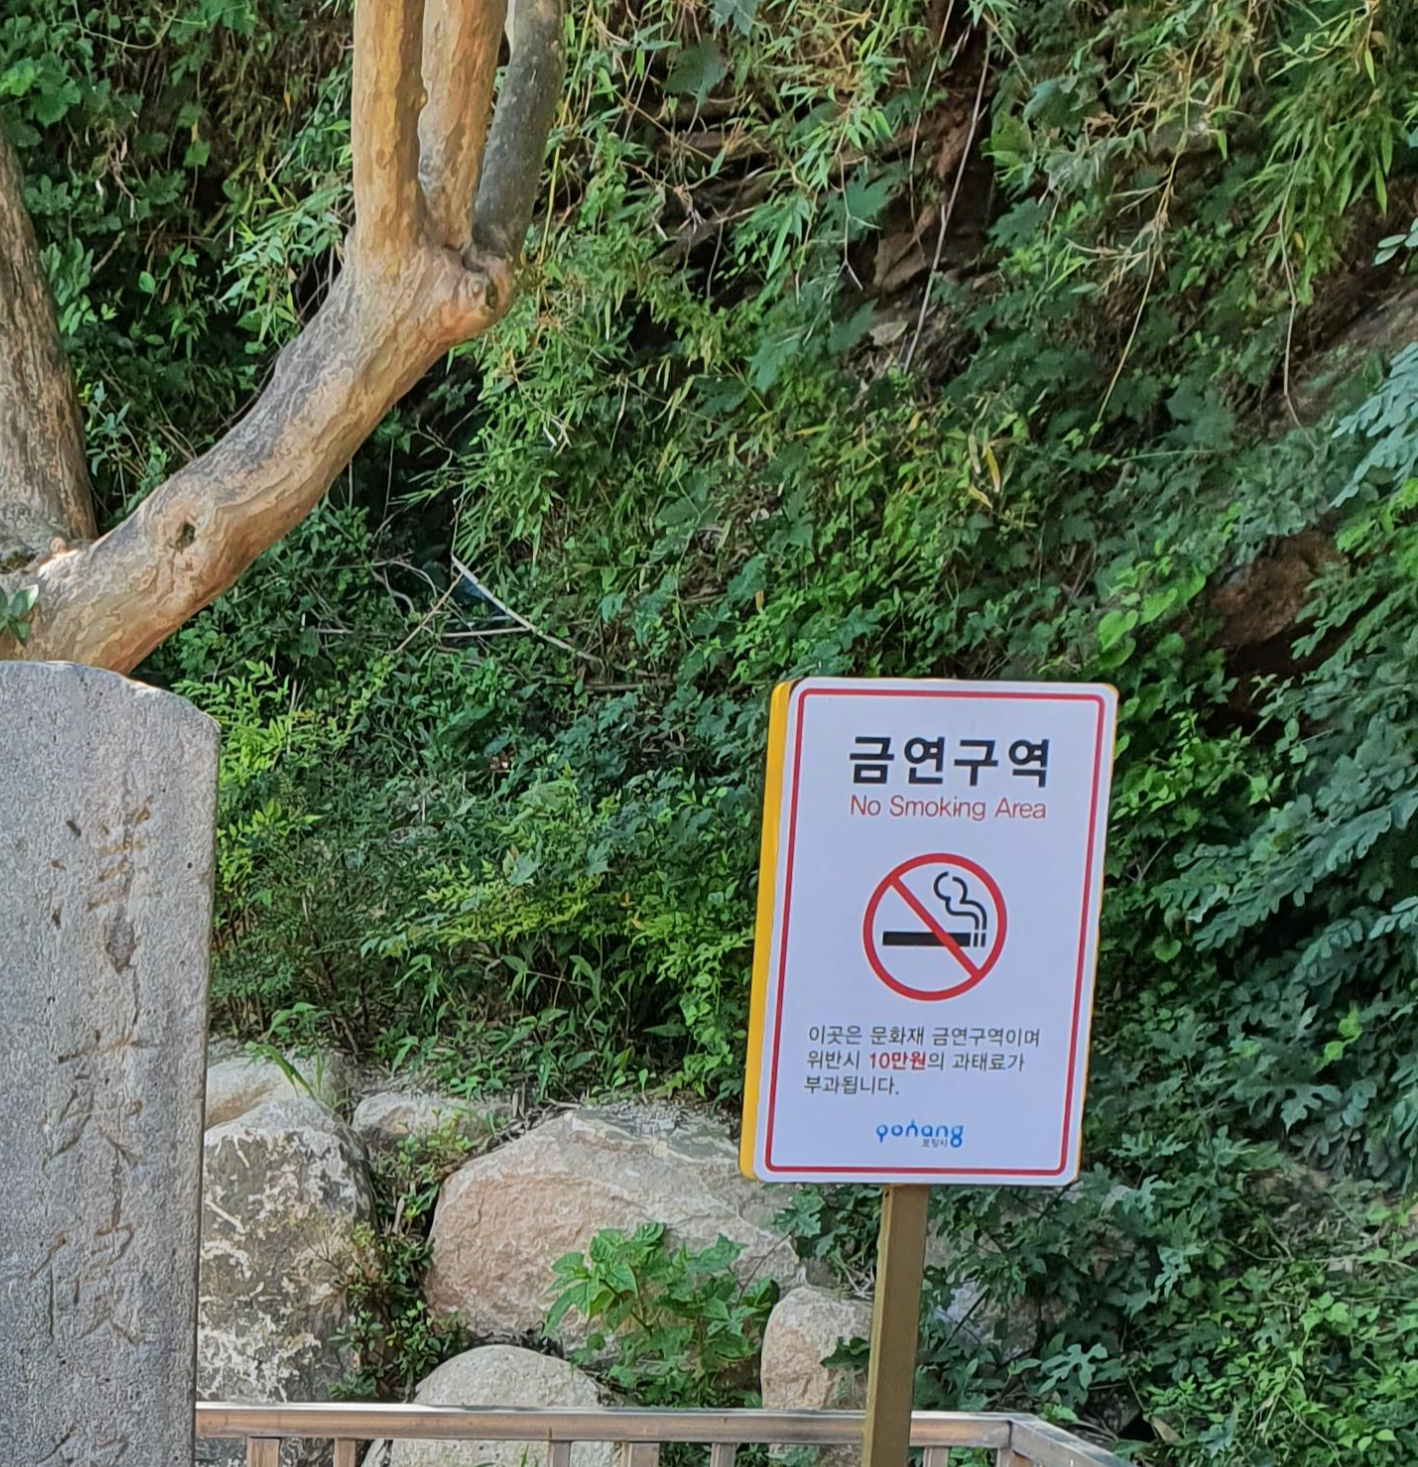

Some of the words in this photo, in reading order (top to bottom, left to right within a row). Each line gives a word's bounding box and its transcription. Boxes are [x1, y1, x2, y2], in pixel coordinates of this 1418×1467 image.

[849, 736, 1050, 788] 금연구역
[850, 794, 882, 816] No
[888, 794, 986, 821] Smoking
[994, 797, 1047, 819] Area
[808, 1025, 863, 1046] 이곳은
[869, 1025, 925, 1046] 문화재
[932, 1027, 1041, 1047] 금연구역이며
[807, 1050, 861, 1070] 위반시
[869, 1051, 945, 1071] 10만원의
[951, 1052, 1025, 1072] 과태료가
[804, 1075, 900, 1095] 부과됩니다.
